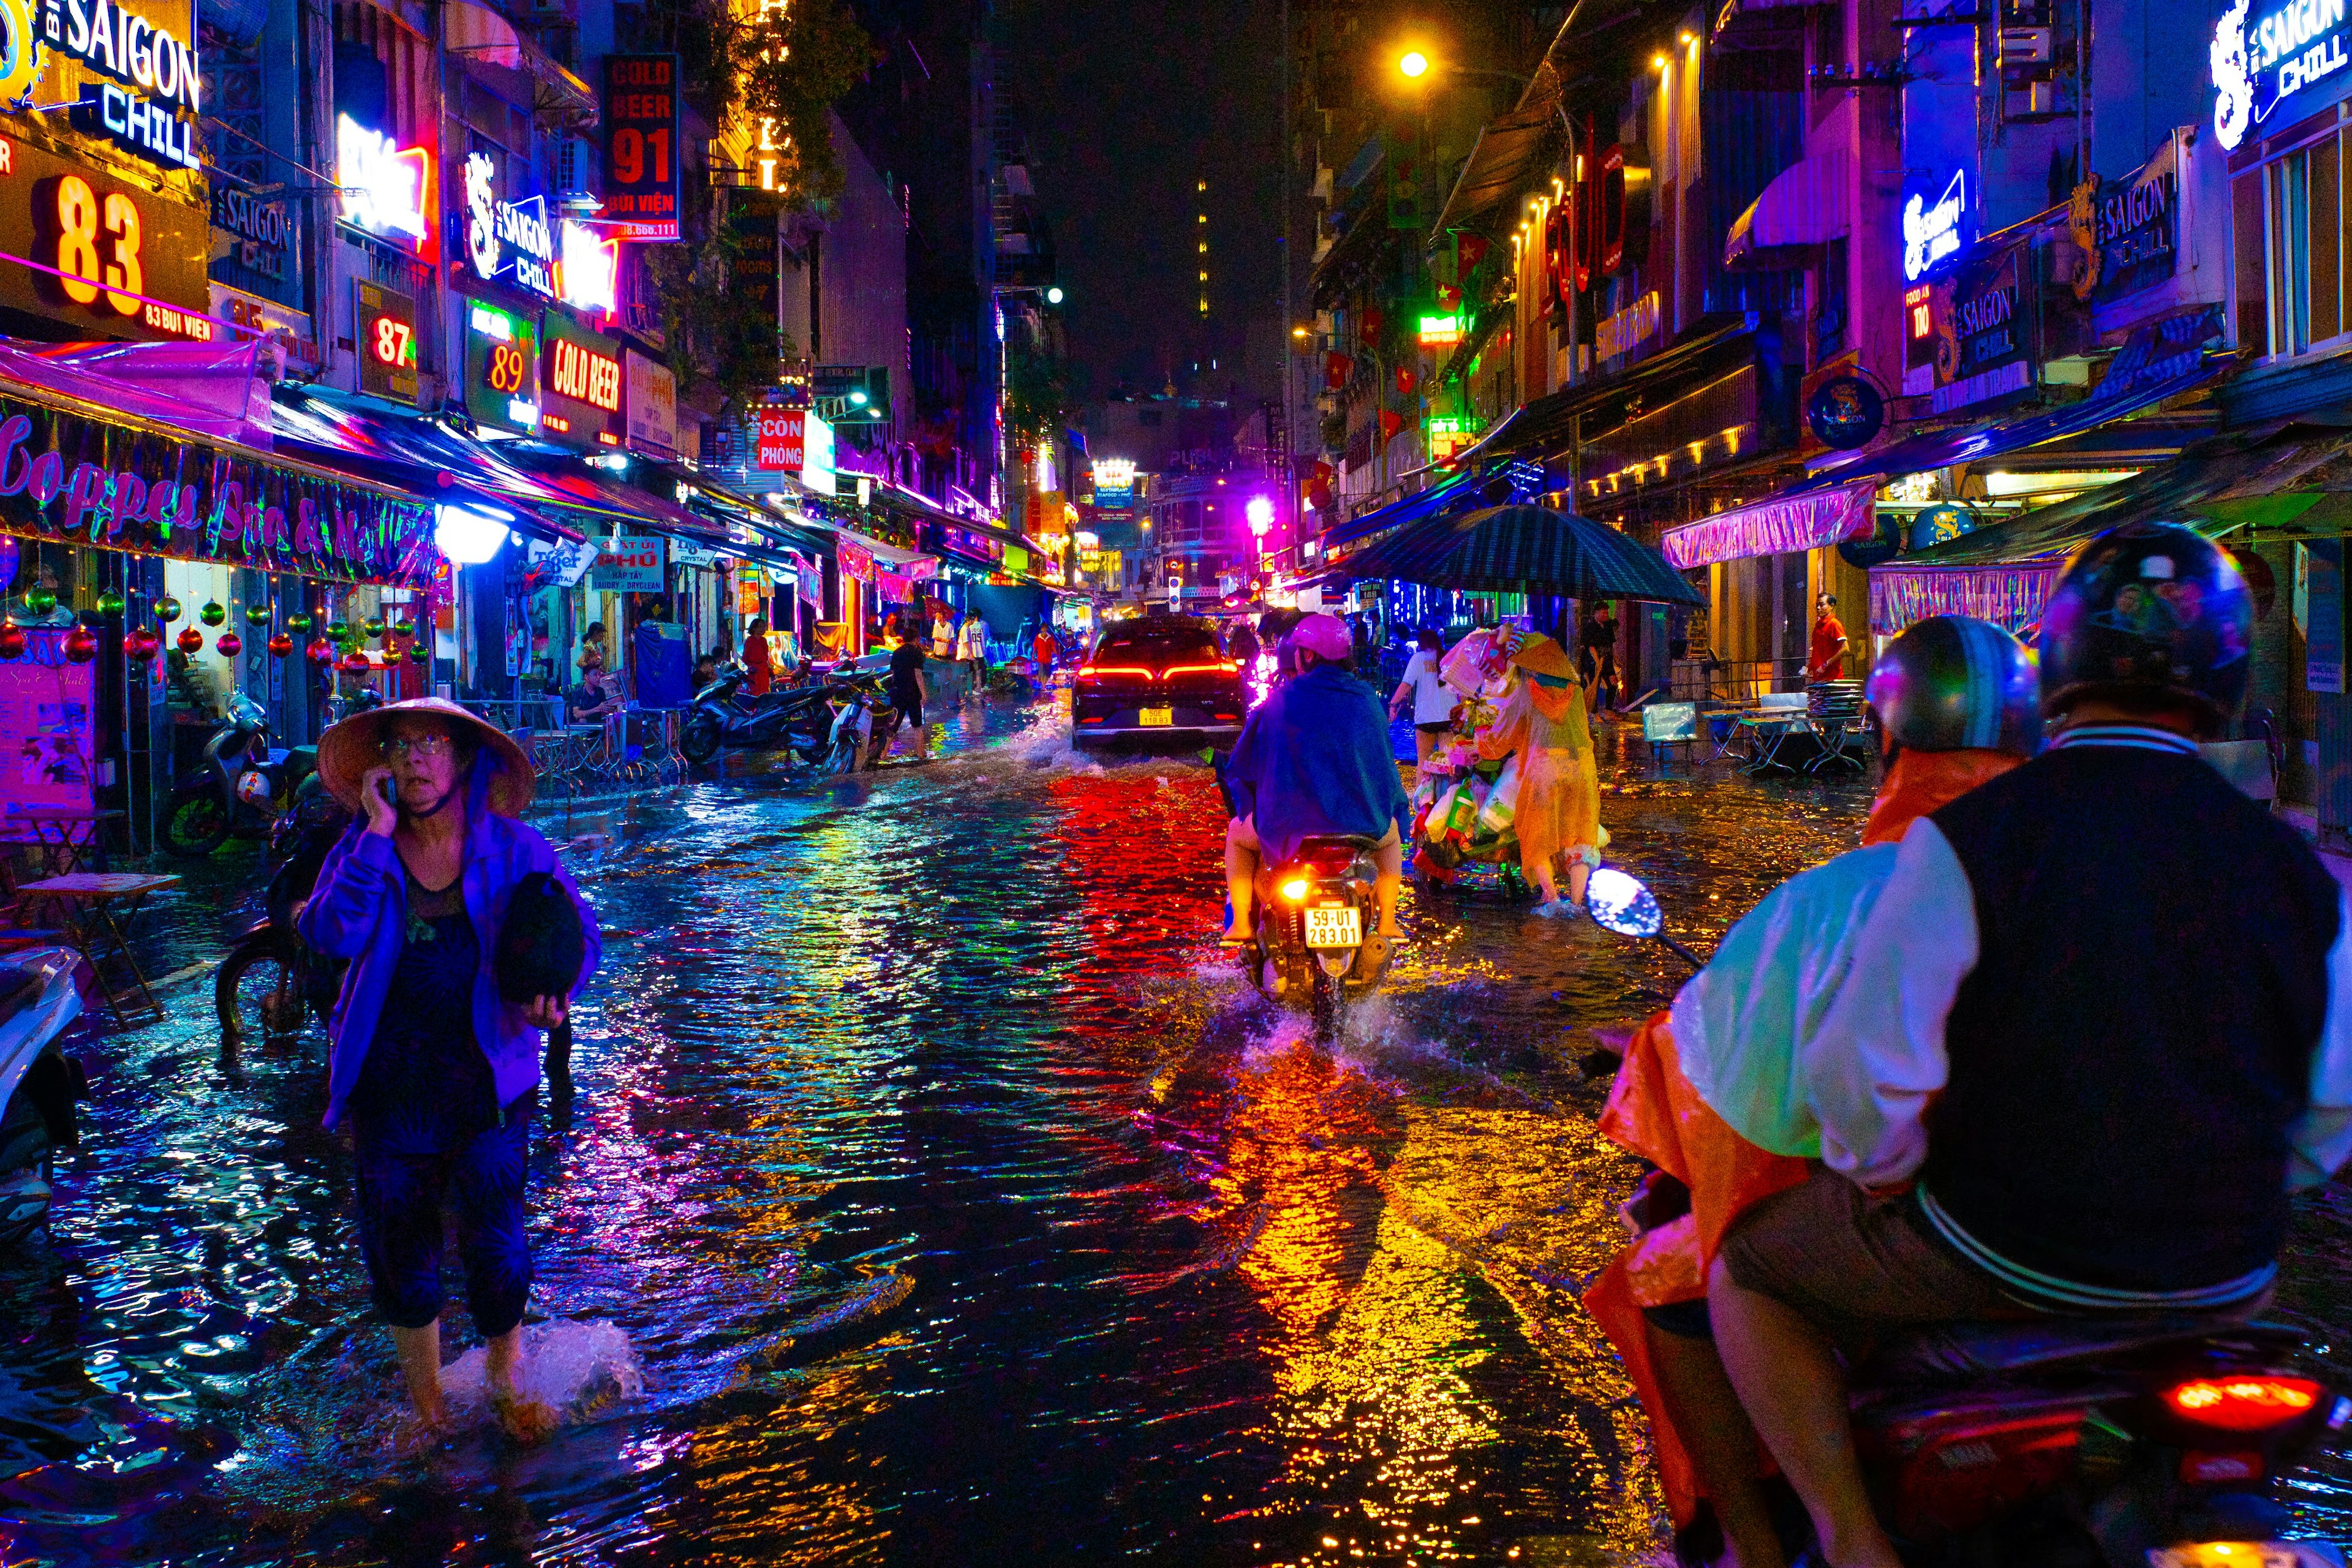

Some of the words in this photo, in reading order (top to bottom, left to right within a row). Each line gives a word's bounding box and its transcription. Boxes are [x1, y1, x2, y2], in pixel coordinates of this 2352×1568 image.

[67, 0, 200, 113] SAIGON
[2260, 0, 2344, 66] SAIGON
[613, 61, 670, 86] COLD
[2280, 34, 2348, 98] CHILL
[104, 83, 200, 170] CHILL
[613, 94, 670, 118] BEER
[614, 128, 669, 183] 91
[227, 189, 291, 251] SAIGON
[638, 191, 674, 215] VIỆN
[2105, 173, 2165, 239] SAIGON
[58, 175, 143, 316] 83
[503, 201, 552, 263] SAIGON
[517, 256, 554, 298] CHILL
[1905, 291, 1921, 306] FOOD
[145, 304, 161, 328] 83
[1963, 288, 2011, 337] SAIGON
[378, 317, 410, 367] 87
[491, 345, 523, 393] 89
[554, 337, 588, 399] COLD
[589, 353, 620, 412] BEER
[761, 415, 802, 437] CÒN
[761, 443, 802, 465] PHÒNG
[971, 633, 982, 643] 05
[1309, 928, 1356, 944] 283.01
